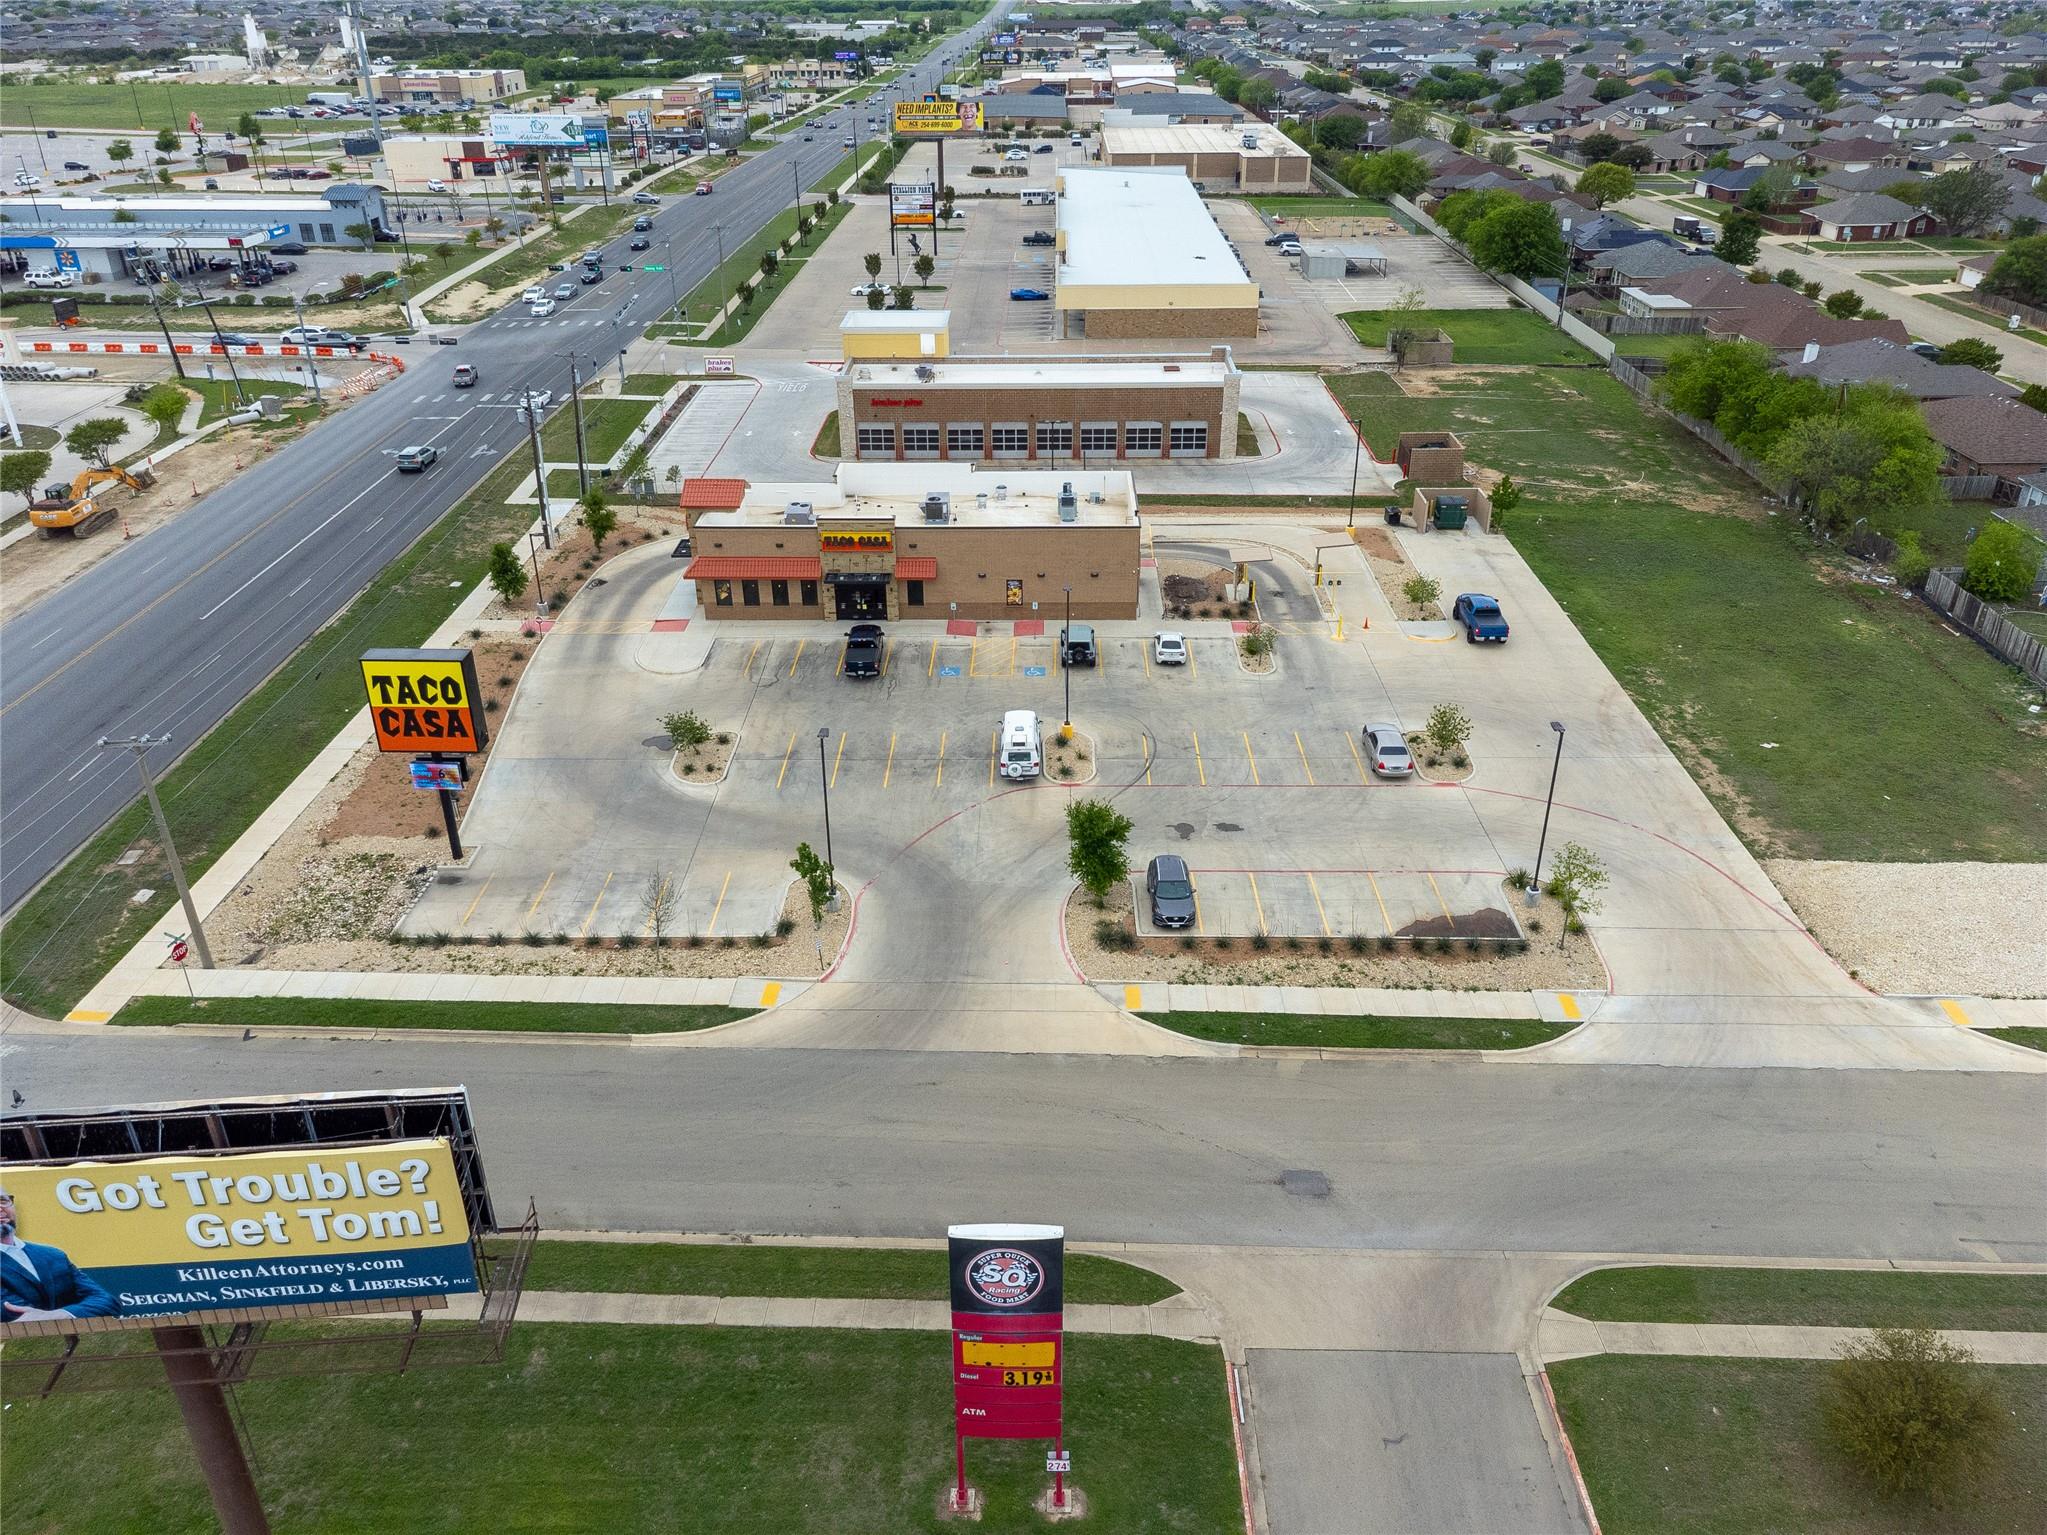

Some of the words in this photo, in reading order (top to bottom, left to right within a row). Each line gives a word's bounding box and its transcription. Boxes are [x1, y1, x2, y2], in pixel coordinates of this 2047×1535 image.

[896, 103, 914, 115] NEED
[914, 103, 954, 115] IMPLANTS?
[892, 186, 917, 194] STALLION
[918, 186, 932, 194] PARK
[778, 382, 809, 392] YIELD
[823, 535, 855, 548] TACO
[858, 535, 888, 547] CASA
[371, 674, 463, 705] TACO
[379, 707, 469, 738] CASA
[172, 944, 188, 960] STOP
[56, 1175, 166, 1214] Got
[171, 1158, 430, 1206] Trouble?
[185, 1211, 290, 1249] Get
[297, 1200, 444, 1242] Tom!
[977, 1252, 1003, 1266] SUPER
[1004, 1252, 1032, 1266] QUICK
[178, 1257, 405, 1283] KilleenAttorneys.com
[981, 1264, 1027, 1287] SQ
[119, 1289, 218, 1307] SEIGMAN,
[220, 1283, 324, 1301] SINKFIELD
[329, 1282, 345, 1294] &
[346, 1275, 449, 1294] LIBERSKY,
[453, 1277, 472, 1285] PLLC
[980, 1290, 1004, 1303] FOOD
[1006, 1291, 1029, 1304] MART
[988, 1287, 1021, 1295] Racing
[959, 1333, 983, 1342] Regular
[960, 1372, 979, 1380] Diesel
[962, 1407, 987, 1416] ATM
[1047, 1462, 1067, 1470] 274
